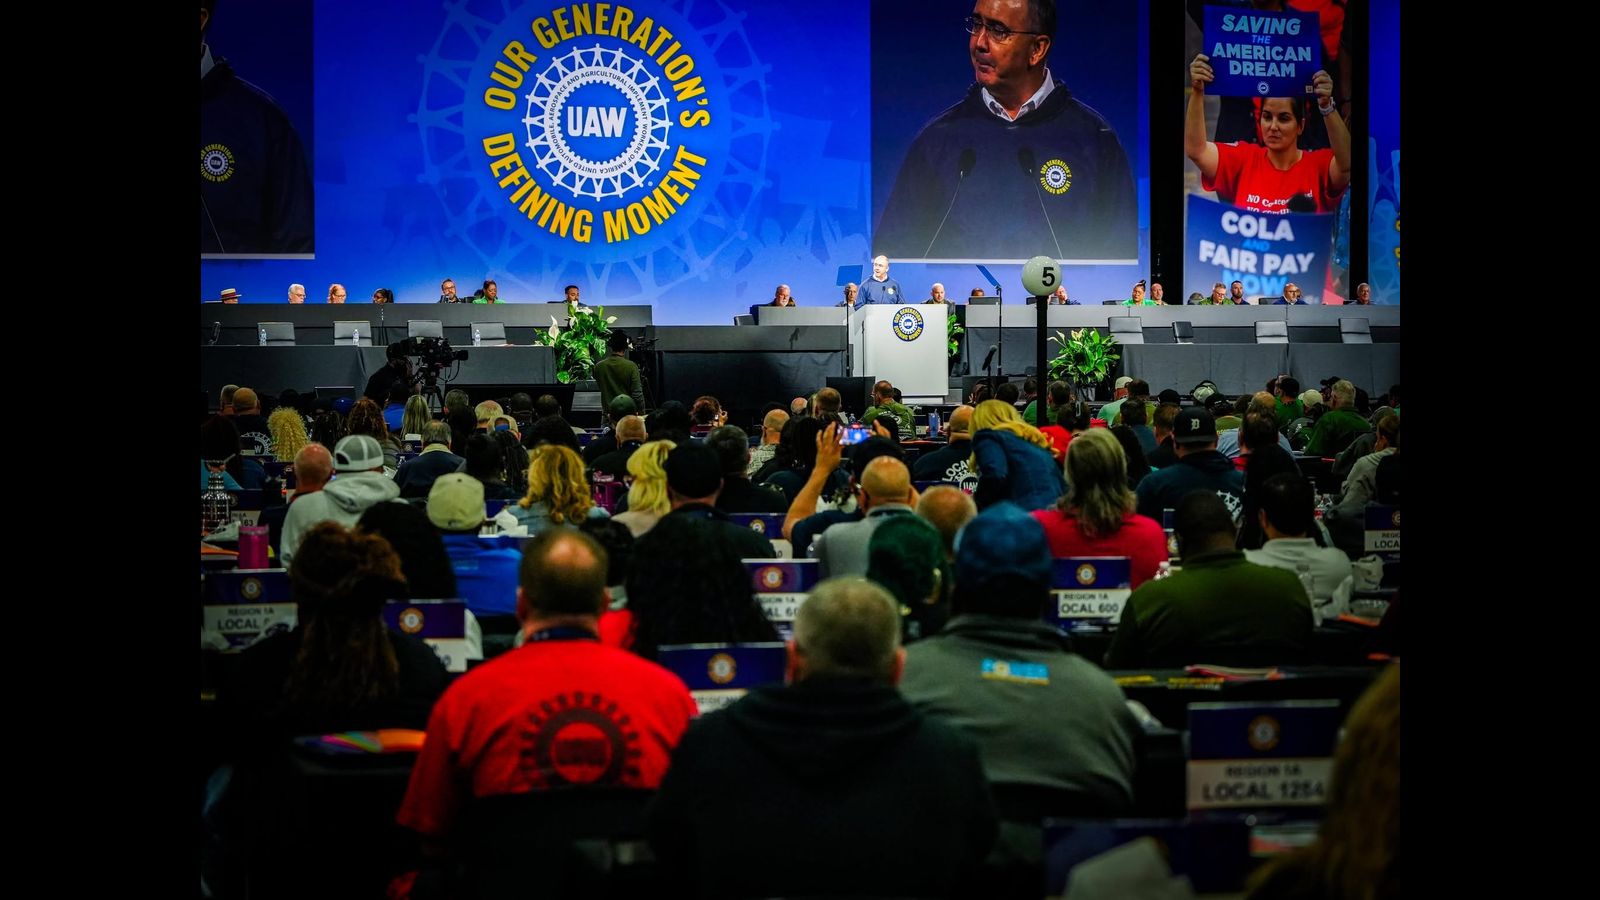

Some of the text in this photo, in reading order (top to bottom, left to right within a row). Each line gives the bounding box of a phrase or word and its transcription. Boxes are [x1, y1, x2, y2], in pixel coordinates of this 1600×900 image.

[1221, 14, 1302, 36] SAVING
[1251, 34, 1272, 44] THE
[1212, 42, 1312, 62] AMERICAN
[484, 2, 712, 129] OUR GENERATION'S
[1229, 60, 1296, 78] DREAM
[566, 74, 580, 86] AND
[580, 70, 628, 87] AGRICULTURAL
[549, 84, 568, 121] AEROSPACE
[627, 84, 648, 121] IMPLEMENT
[567, 106, 628, 138] UAW
[633, 123, 648, 155] WORKERS
[573, 162, 597, 174] UNITED
[599, 162, 628, 174] AMERICA
[626, 153, 636, 163] OF
[482, 132, 709, 244] DEFINING MOMENT
[1221, 210, 1295, 242] COLA
[1242, 239, 1270, 252] AND
[1199, 239, 1316, 276] FAIR PAY
[1042, 266, 1055, 287] 5
[1222, 269, 1289, 297] NOW
[941, 459, 971, 482] LOCA
[1374, 540, 1400, 549] LOCA
[1061, 603, 1119, 614] OCAL 600
[217, 619, 260, 631] LOCAL
[1202, 781, 1272, 800] LOCAL
